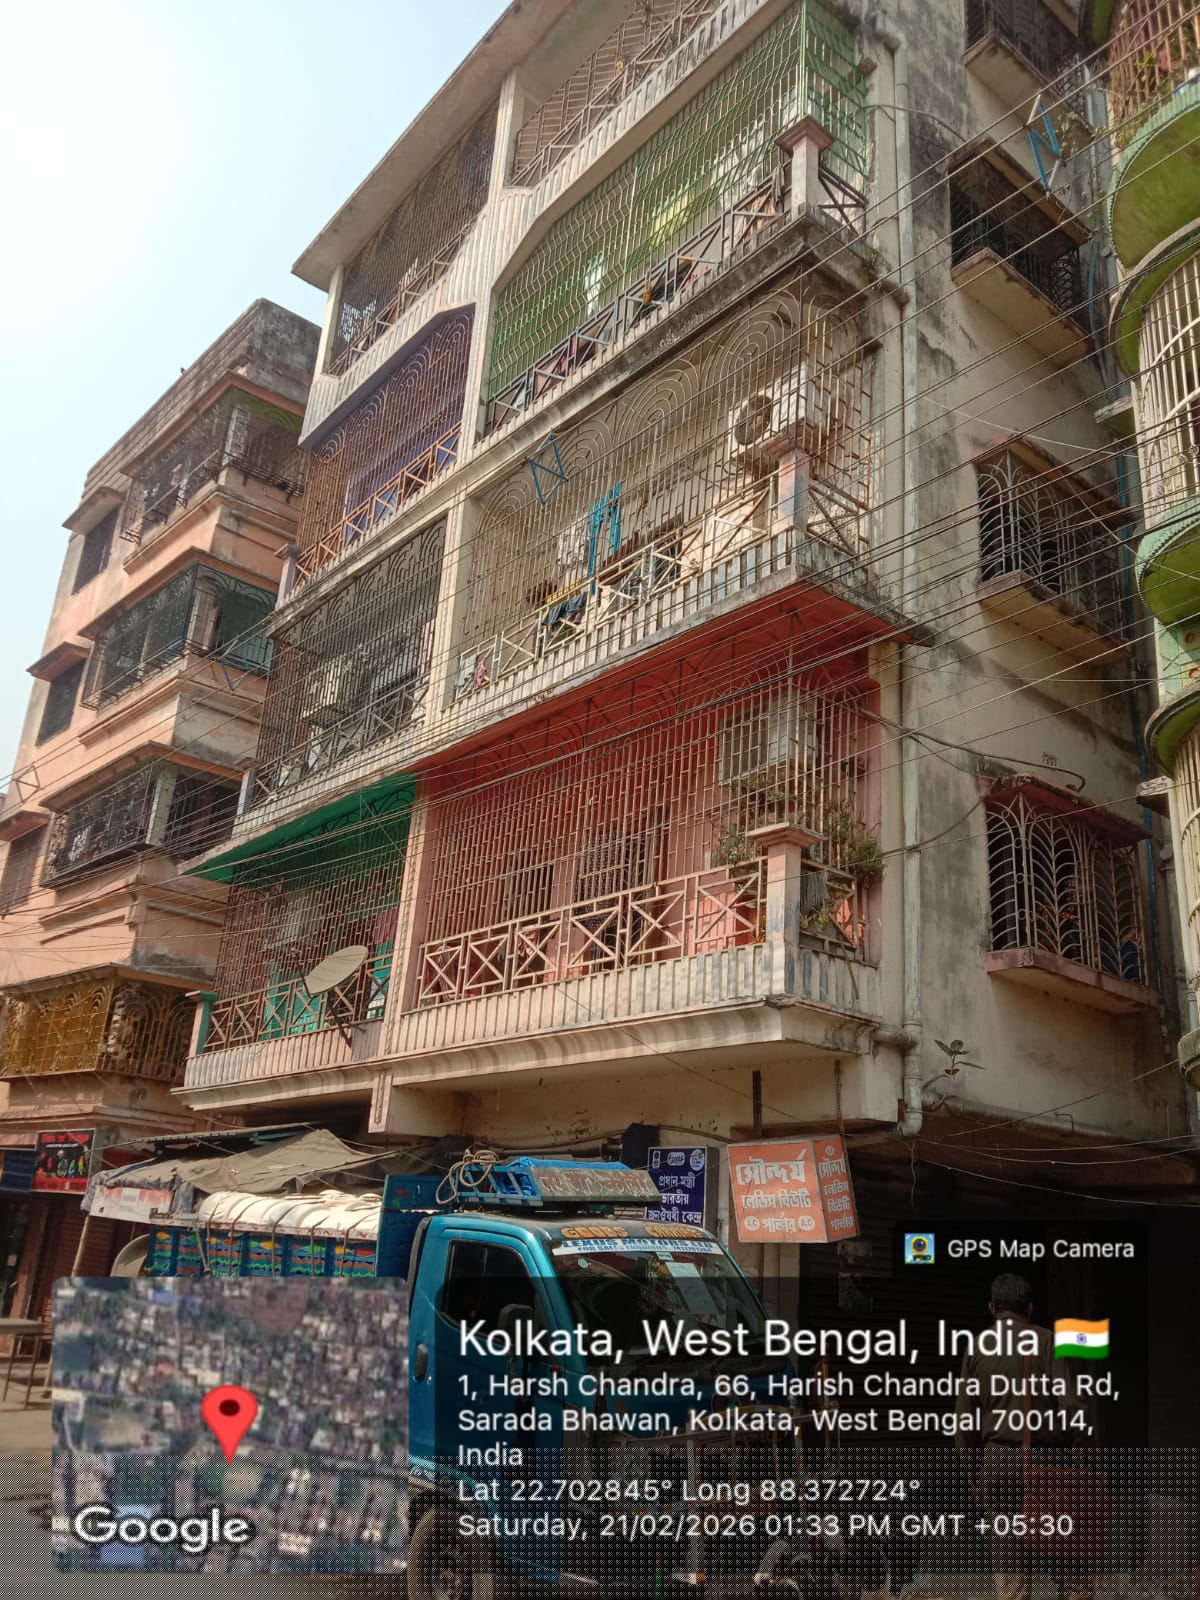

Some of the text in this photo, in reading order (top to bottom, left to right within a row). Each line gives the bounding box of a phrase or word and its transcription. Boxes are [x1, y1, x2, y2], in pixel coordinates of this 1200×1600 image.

[736, 1148, 807, 1185] সৌন্দর্য
[778, 1188, 811, 1208] বিউটি
[561, 1227, 628, 1238] GOODS
[762, 1212, 796, 1234] পার্লার
[621, 1239, 689, 1247] MOTORS
